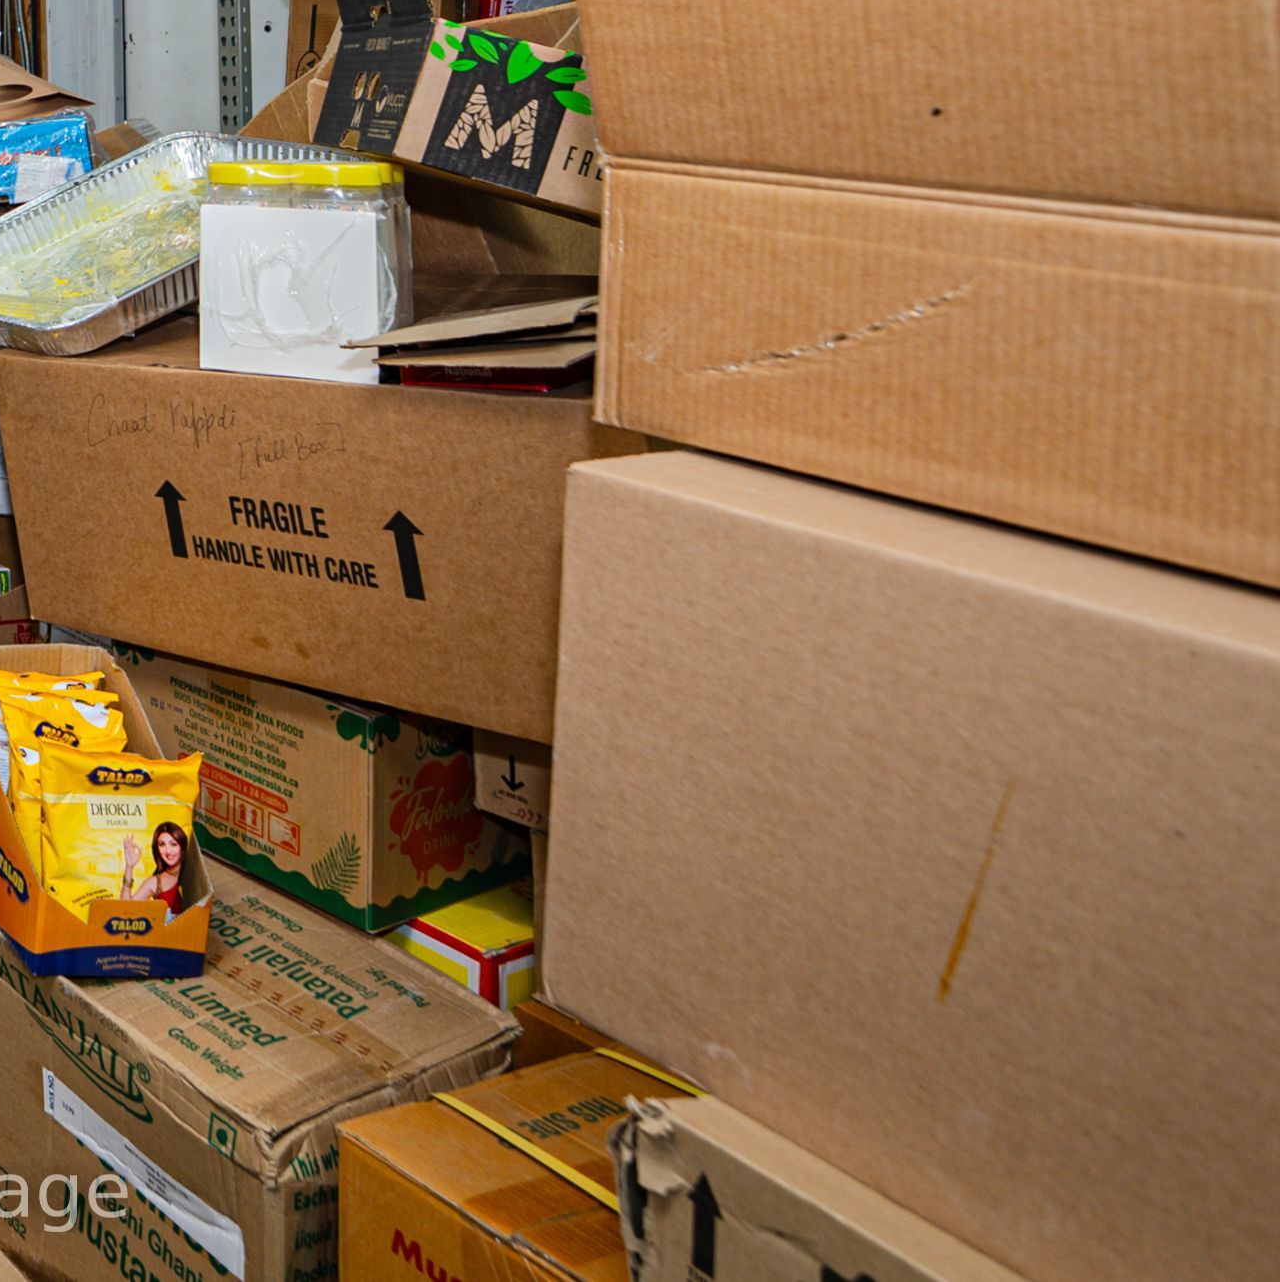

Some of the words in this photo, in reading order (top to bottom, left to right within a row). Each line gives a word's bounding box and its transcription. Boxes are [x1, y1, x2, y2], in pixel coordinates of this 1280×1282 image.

[444, 365, 492, 379] National
[229, 495, 329, 539] FRAGILE
[193, 535, 266, 573] HANDLE
[268, 551, 322, 580] WITH
[325, 557, 380, 590] CARE
[169, 676, 208, 700] PREPARED
[210, 693, 225, 707] FOR
[227, 698, 253, 718] SUPER
[255, 710, 274, 726] ASIA
[276, 718, 305, 739] FOODS
[96, 770, 145, 784] TALOD
[90, 802, 143, 817] DHOKLA
[197, 812, 228, 833] PRODUCT
[230, 826, 239, 839] OF
[241, 833, 276, 857] VIETNAM
[111, 920, 146, 932] TALOD
[242, 944, 369, 1020] Patanjali
[143, 981, 199, 1021] Industries
[196, 1018, 247, 1052] Limited)
[178, 983, 288, 1049] Limited
[167, 1026, 200, 1052] Gross
[199, 1048, 246, 1081] Weight
[572, 1095, 626, 1124] THIS
[290, 1152, 321, 1182] This
[294, 1188, 331, 1212] Each
